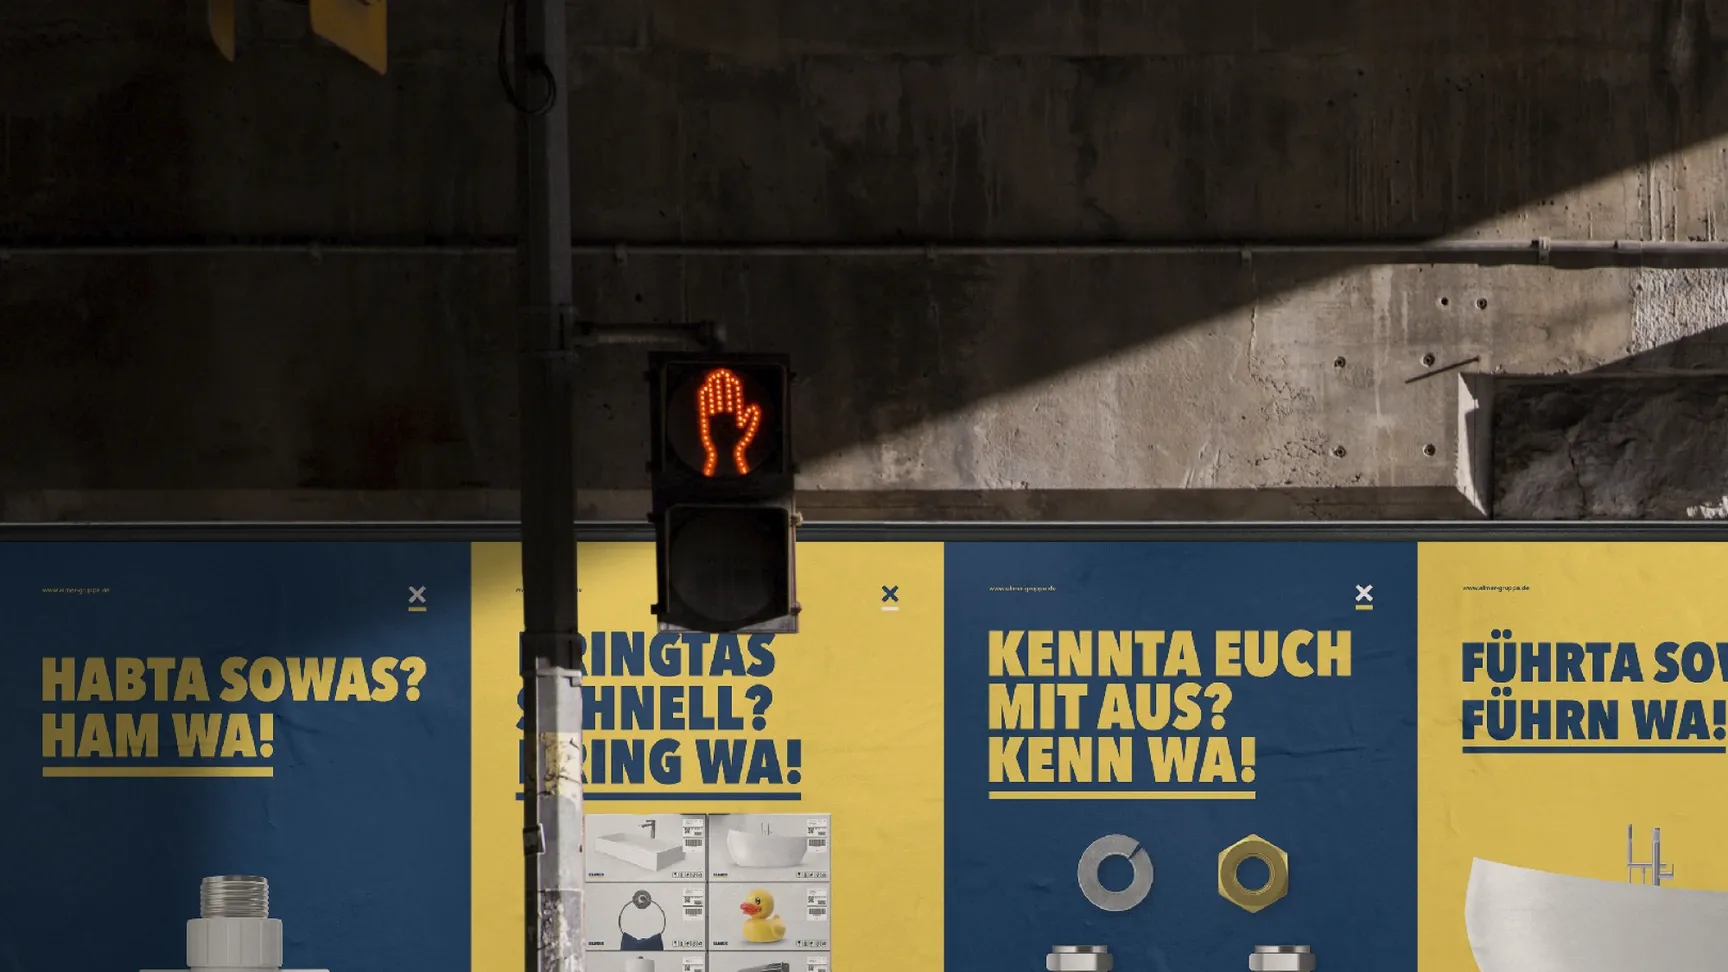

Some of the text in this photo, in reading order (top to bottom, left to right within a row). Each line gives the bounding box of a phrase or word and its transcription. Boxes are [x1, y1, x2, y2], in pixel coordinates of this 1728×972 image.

[989, 630, 1351, 677] KENNTA EUCH
[1462, 629, 1643, 683] FÜHRTA
[42, 656, 426, 702] HABTA SOWAS?
[989, 682, 1232, 730] MIT AUS?
[1462, 686, 1726, 740] FÜHRN WA!
[42, 713, 274, 758] HAM WA!
[696, 740, 801, 784] WA!
[989, 736, 1255, 782] KENN WA!
